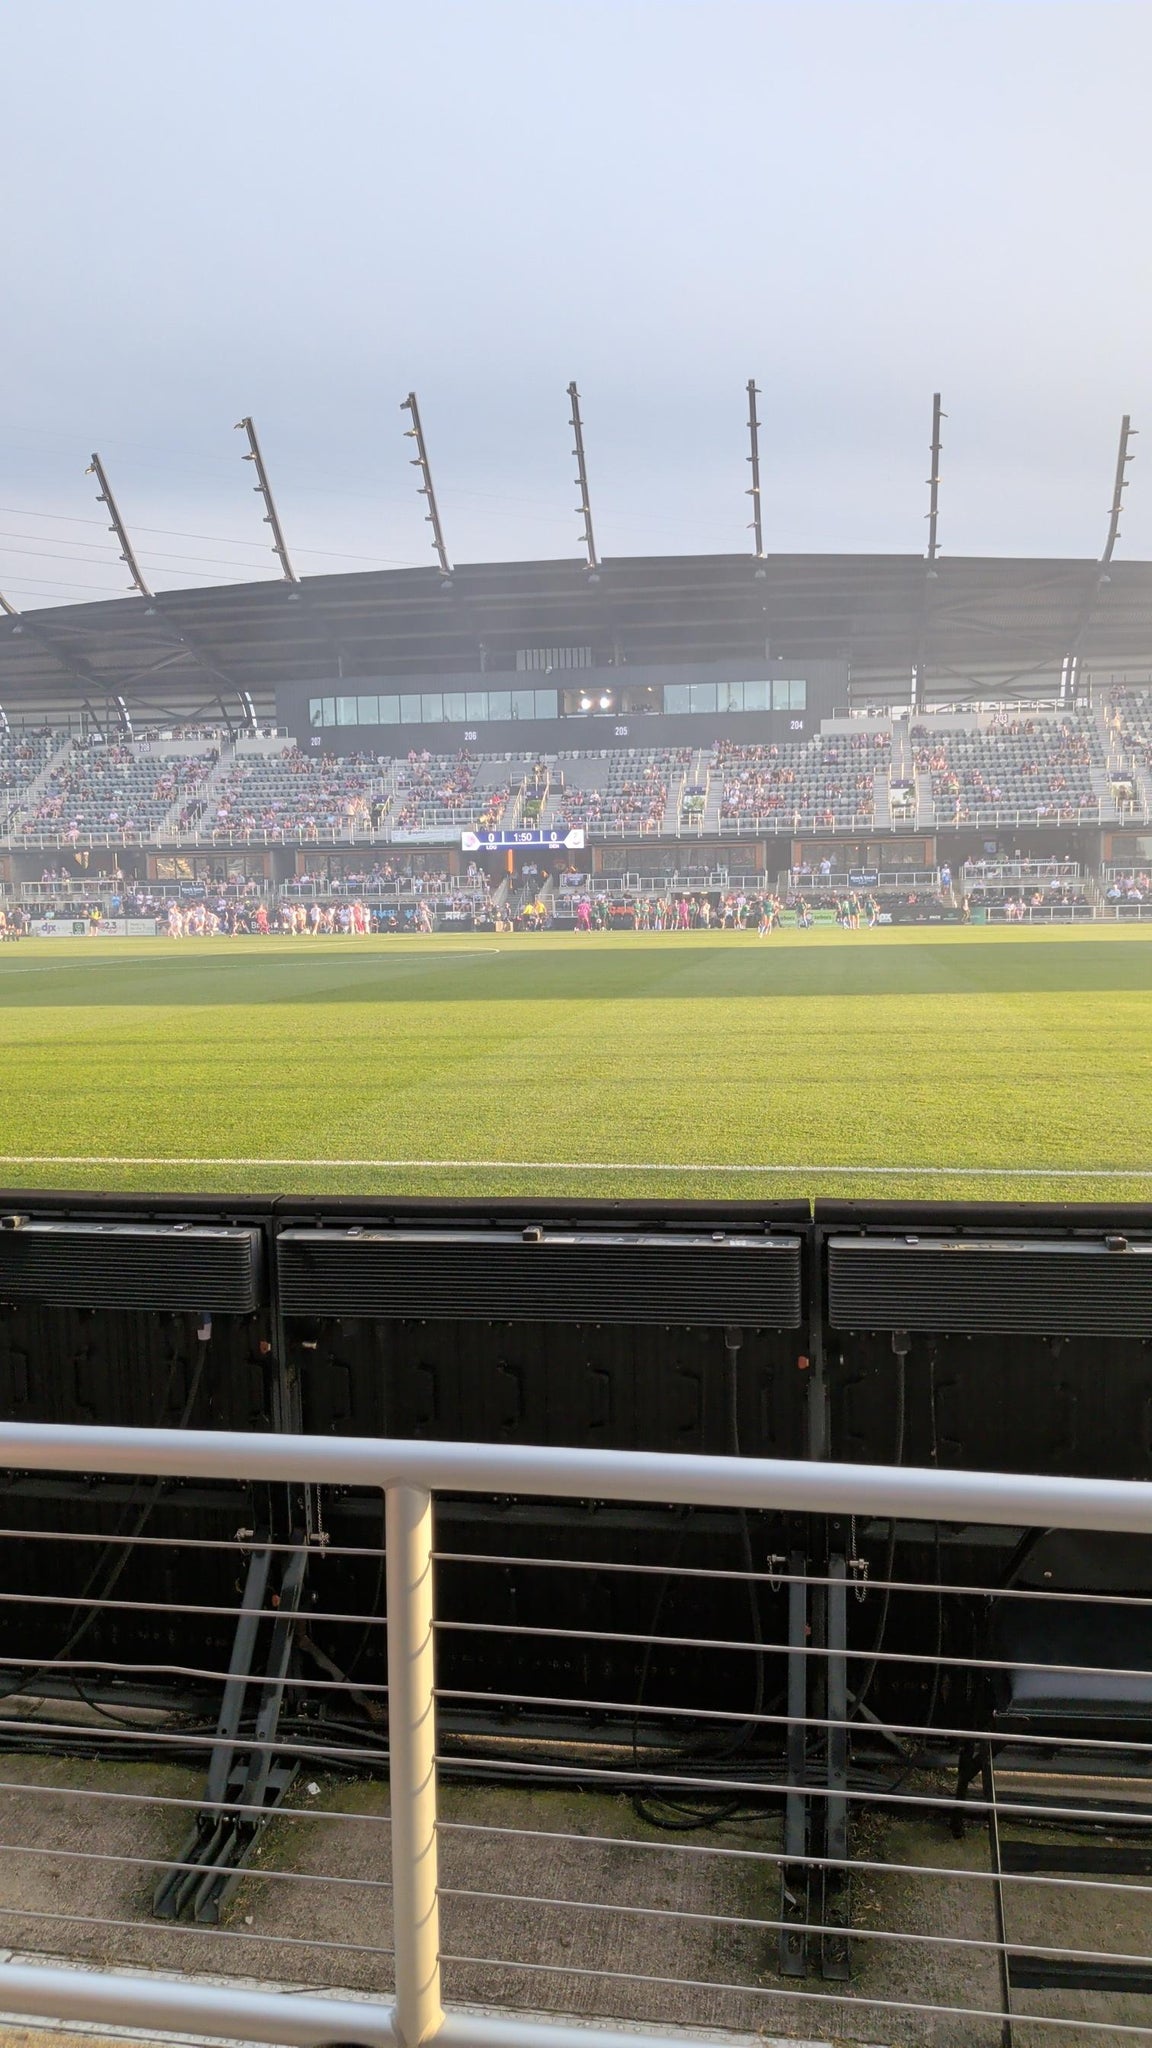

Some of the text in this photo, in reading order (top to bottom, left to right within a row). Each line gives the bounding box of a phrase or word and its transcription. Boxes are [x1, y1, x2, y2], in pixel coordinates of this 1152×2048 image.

[790, 720, 803, 730] 204
[464, 731, 477, 741] 206
[614, 726, 628, 736] 205
[310, 737, 321, 746] 207
[488, 833, 495, 842] 0
[514, 833, 532, 842] 1:50
[551, 831, 558, 841] 0
